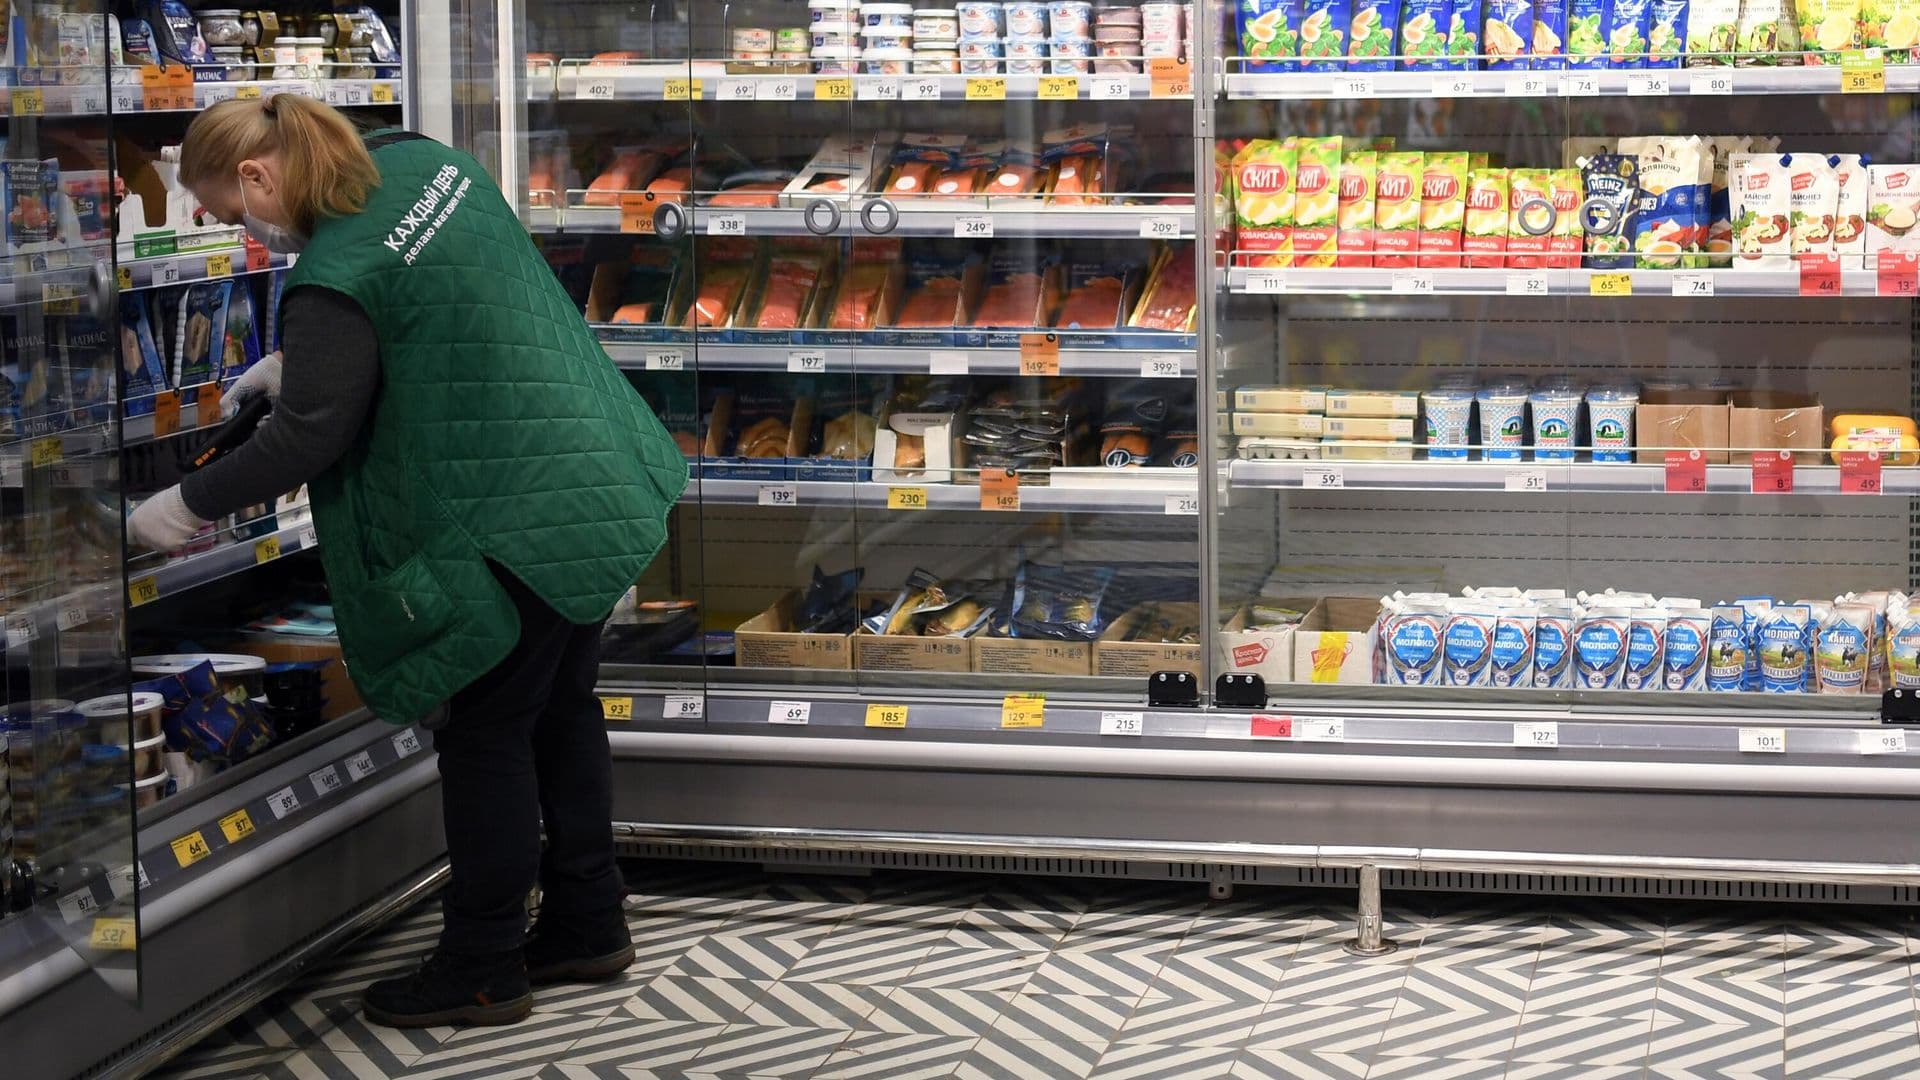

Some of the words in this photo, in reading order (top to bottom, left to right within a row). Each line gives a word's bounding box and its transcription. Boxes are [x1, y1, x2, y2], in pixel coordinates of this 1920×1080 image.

[1453, 82, 1466, 91] 67
[1525, 82, 1538, 91] 87
[1578, 82, 1591, 91] 74
[1647, 81, 1660, 90] 36
[1711, 80, 1725, 89] 80
[1852, 77, 1865, 86] 58
[589, 86, 608, 95] 402
[667, 86, 685, 95] 309
[735, 86, 748, 95] 69
[775, 85, 788, 95] 69
[828, 85, 846, 95] 132
[878, 86, 890, 95] 94
[919, 85, 933, 95] 99
[976, 85, 988, 94] 79
[1048, 84, 1060, 94] 79
[1110, 84, 1122, 94] 53
[1170, 84, 1183, 94] 69
[1349, 83, 1366, 92] 115
[1242, 166, 1280, 188] СКИТ
[1297, 167, 1321, 188] КИТ
[1340, 178, 1360, 196] КИТ
[1590, 179, 1622, 191] HEINZ
[1552, 192, 1574, 208] КИТ
[384, 185, 442, 252] КАЖДЫЙ
[432, 164, 459, 195] ДЕНЬ
[636, 219, 652, 229] 199
[719, 220, 738, 230] 338
[966, 222, 986, 232] 249
[1152, 222, 1172, 232] 209
[403, 227, 436, 266] делаю
[432, 196, 460, 229] магазин
[165, 270, 173, 279] 87
[1264, 279, 1278, 288] 111
[1414, 280, 1426, 289] 74
[1527, 280, 1539, 289] 52
[1600, 280, 1613, 290] 65
[1693, 281, 1706, 291] 74
[1819, 281, 1833, 290] 44
[1898, 280, 1910, 290] 13
[658, 355, 676, 365] 197
[800, 357, 819, 367] 197
[1026, 361, 1043, 371] 149
[1152, 362, 1173, 372] 399
[1321, 474, 1335, 484] 59
[1526, 477, 1538, 487] 51
[1693, 479, 1699, 487] 8
[1777, 479, 1784, 488] 8
[1861, 480, 1875, 489] 49
[772, 490, 789, 500] 139
[900, 494, 919, 504] 230
[996, 496, 1013, 505] 149
[1179, 500, 1197, 510] 214
[138, 585, 152, 598] 170
[1716, 628, 1739, 638] ЛОКО
[1764, 629, 1800, 639] МОЛОКО
[1828, 631, 1855, 644] КАКАО
[1494, 640, 1523, 650] ОЛОКО
[1580, 640, 1619, 650] МОЛОКО
[1667, 641, 1697, 652] ОЛОКО
[610, 704, 623, 714] 93
[681, 702, 695, 712] 89
[787, 708, 801, 718] 69
[880, 712, 898, 722] 185
[1008, 712, 1024, 721] 129
[1116, 719, 1134, 729] 215
[1279, 725, 1285, 734] 6
[1328, 725, 1335, 735] 6
[1533, 731, 1550, 740] 127
[401, 738, 413, 749] 129
[1757, 737, 1775, 746] 101
[1882, 737, 1897, 747] 98
[356, 761, 369, 771] 144
[282, 796, 292, 808] 89
[235, 820, 246, 831] 87
[189, 842, 202, 854] 64
[77, 897, 89, 910] 87
